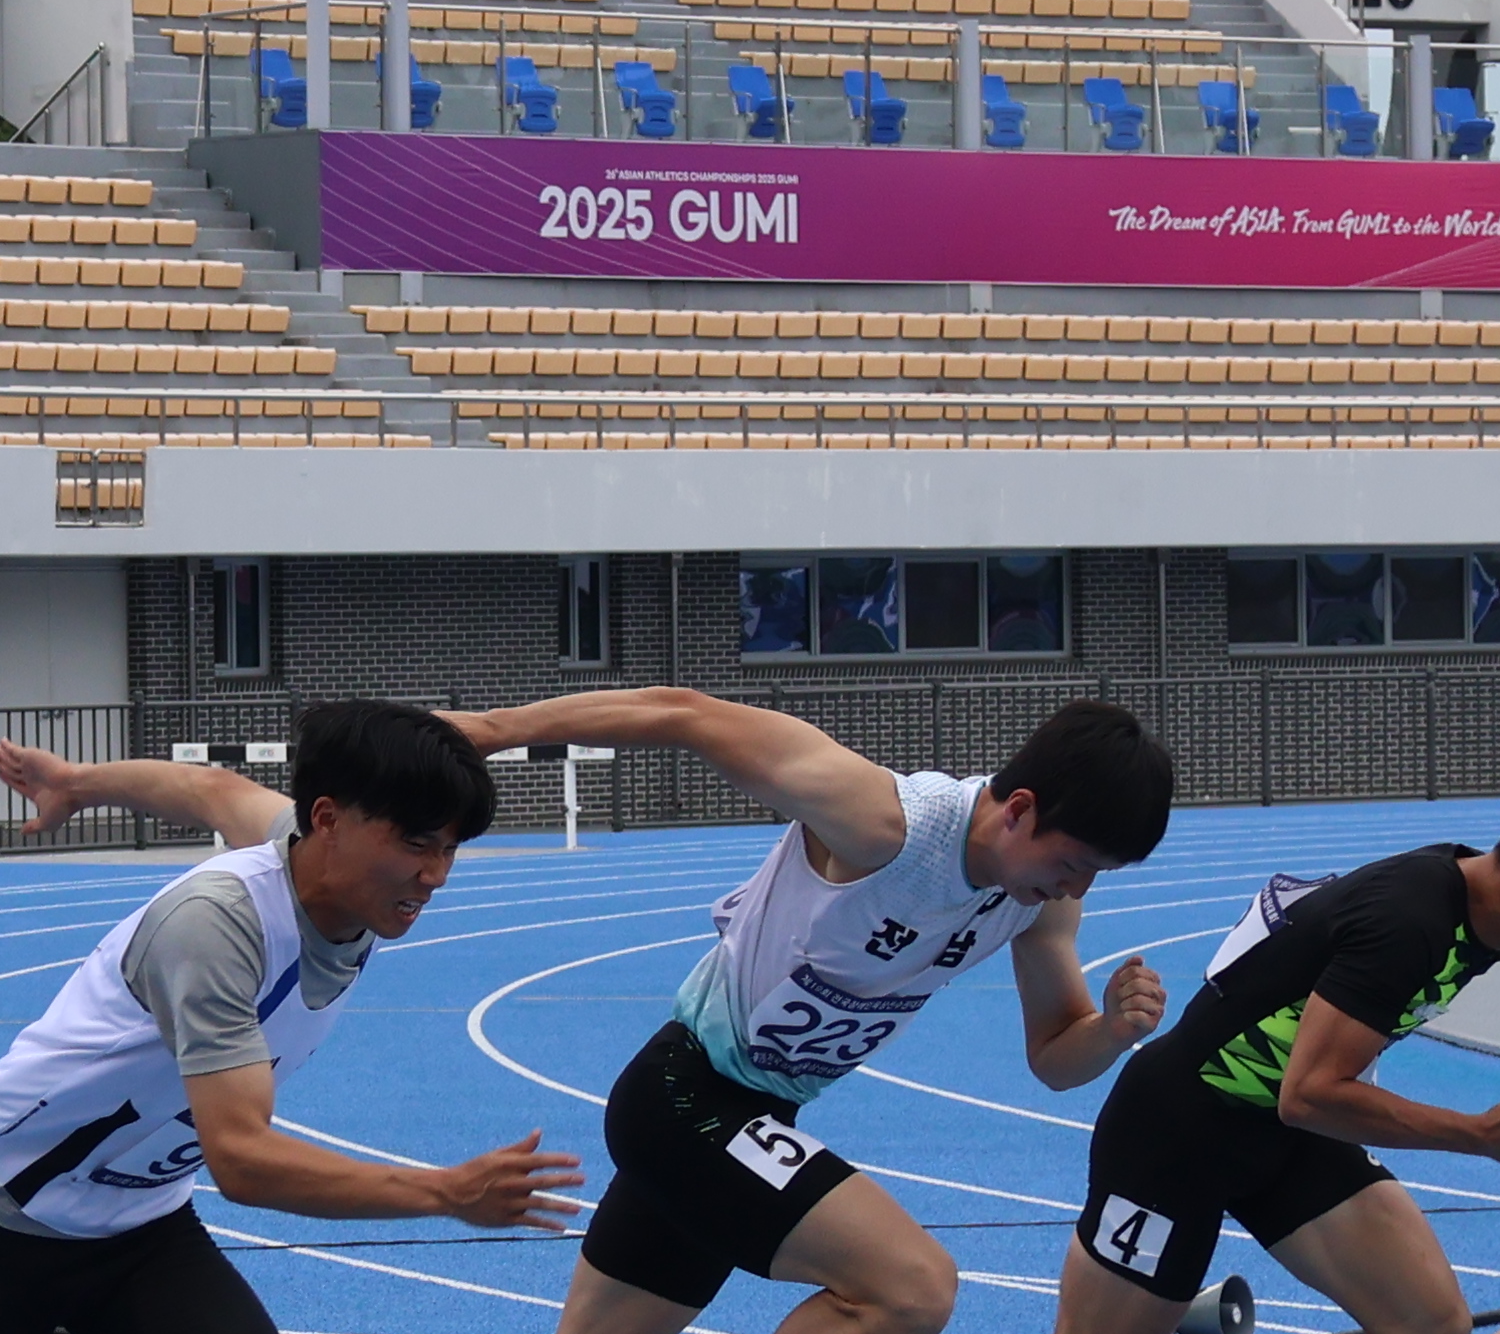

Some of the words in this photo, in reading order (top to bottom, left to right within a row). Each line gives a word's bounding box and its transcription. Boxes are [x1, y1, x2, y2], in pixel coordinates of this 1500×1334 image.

[644, 170, 689, 182] ATHLETICS
[690, 171, 757, 184] CHAMPIONSHIPS
[539, 185, 654, 241] 2025
[669, 188, 799, 244] GUMI
[1108, 205, 1146, 232] The
[1148, 207, 1206, 233] Dream
[1210, 206, 1232, 236] of
[1292, 209, 1334, 234] From
[1336, 210, 1390, 240] GUMI
[1392, 217, 1411, 236] to
[1412, 214, 1440, 236] the
[864, 916, 978, 968] 전남
[757, 1001, 897, 1061] 223
[746, 1118, 807, 1169] 5
[1111, 1208, 1151, 1265] 4
